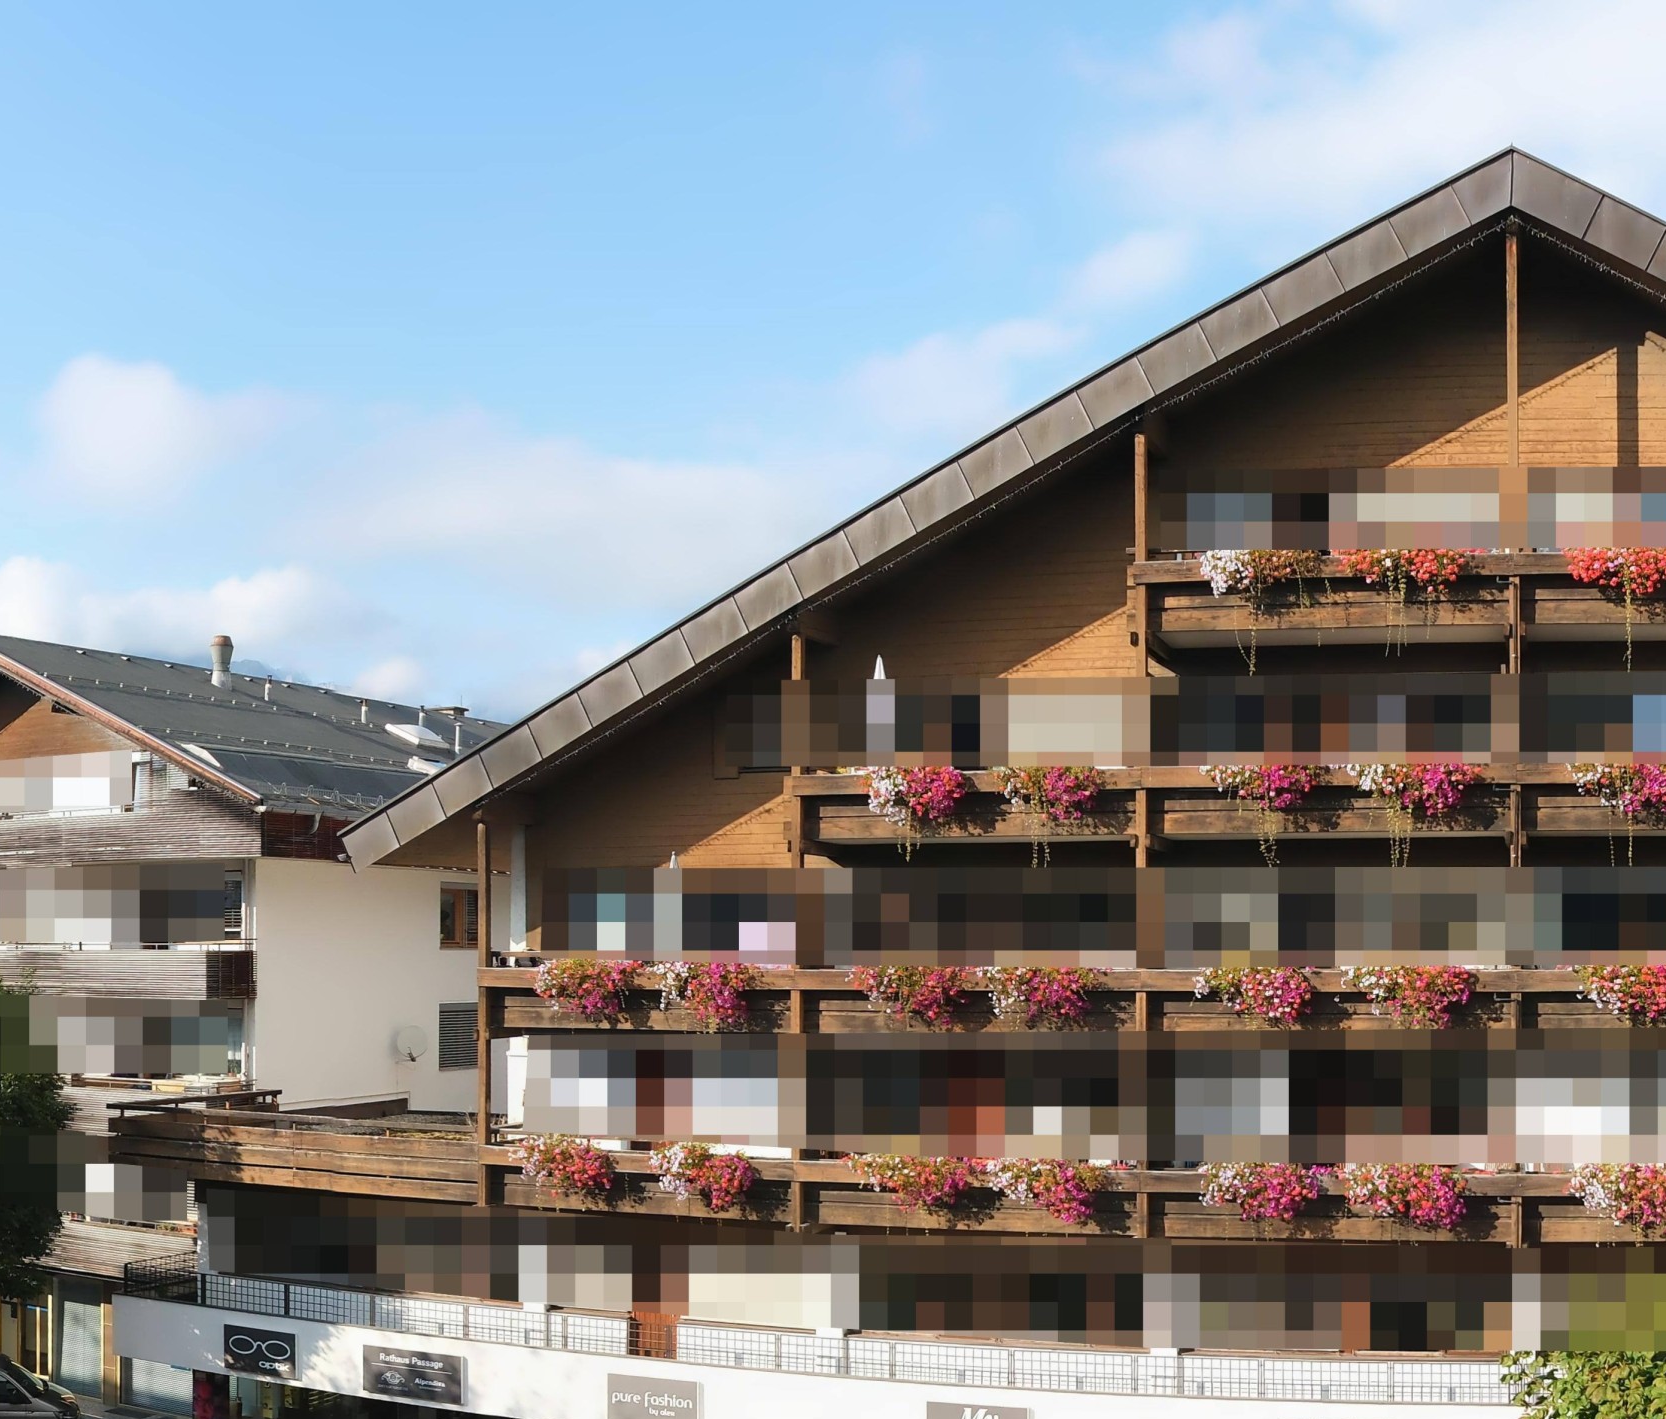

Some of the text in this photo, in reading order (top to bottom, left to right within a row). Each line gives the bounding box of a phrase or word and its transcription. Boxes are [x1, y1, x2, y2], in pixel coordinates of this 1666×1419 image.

[258, 1359, 290, 1373] optik
[379, 1352, 444, 1369] Rathaus Passage
[612, 1391, 693, 1409] pure fashion
[649, 1408, 675, 1417] by alex
